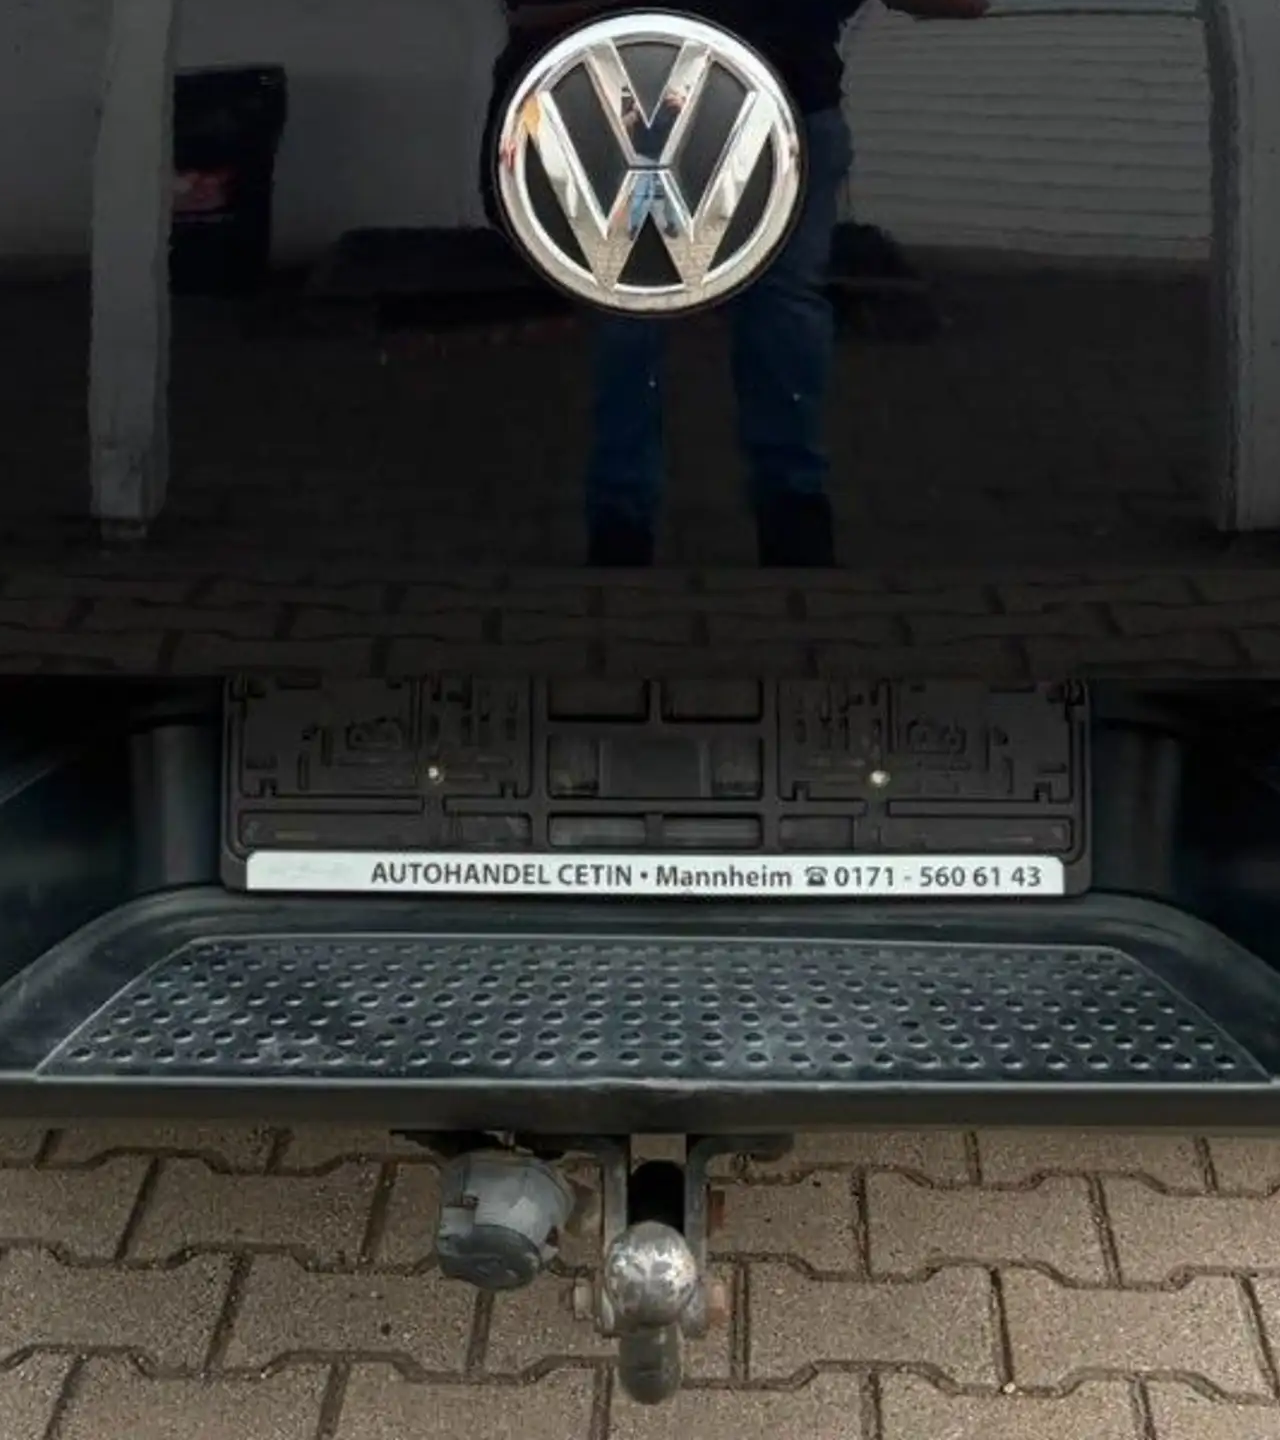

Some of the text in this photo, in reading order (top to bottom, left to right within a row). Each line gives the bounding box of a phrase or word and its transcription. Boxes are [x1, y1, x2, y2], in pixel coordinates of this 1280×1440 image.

[370, 862, 550, 886] AUTOHANDEL
[557, 864, 632, 886] CETIN
[656, 865, 791, 887] Mannheim
[834, 866, 894, 887] 0171
[921, 867, 966, 887] 560
[973, 866, 1001, 887] 61
[1011, 867, 1042, 887] 43
